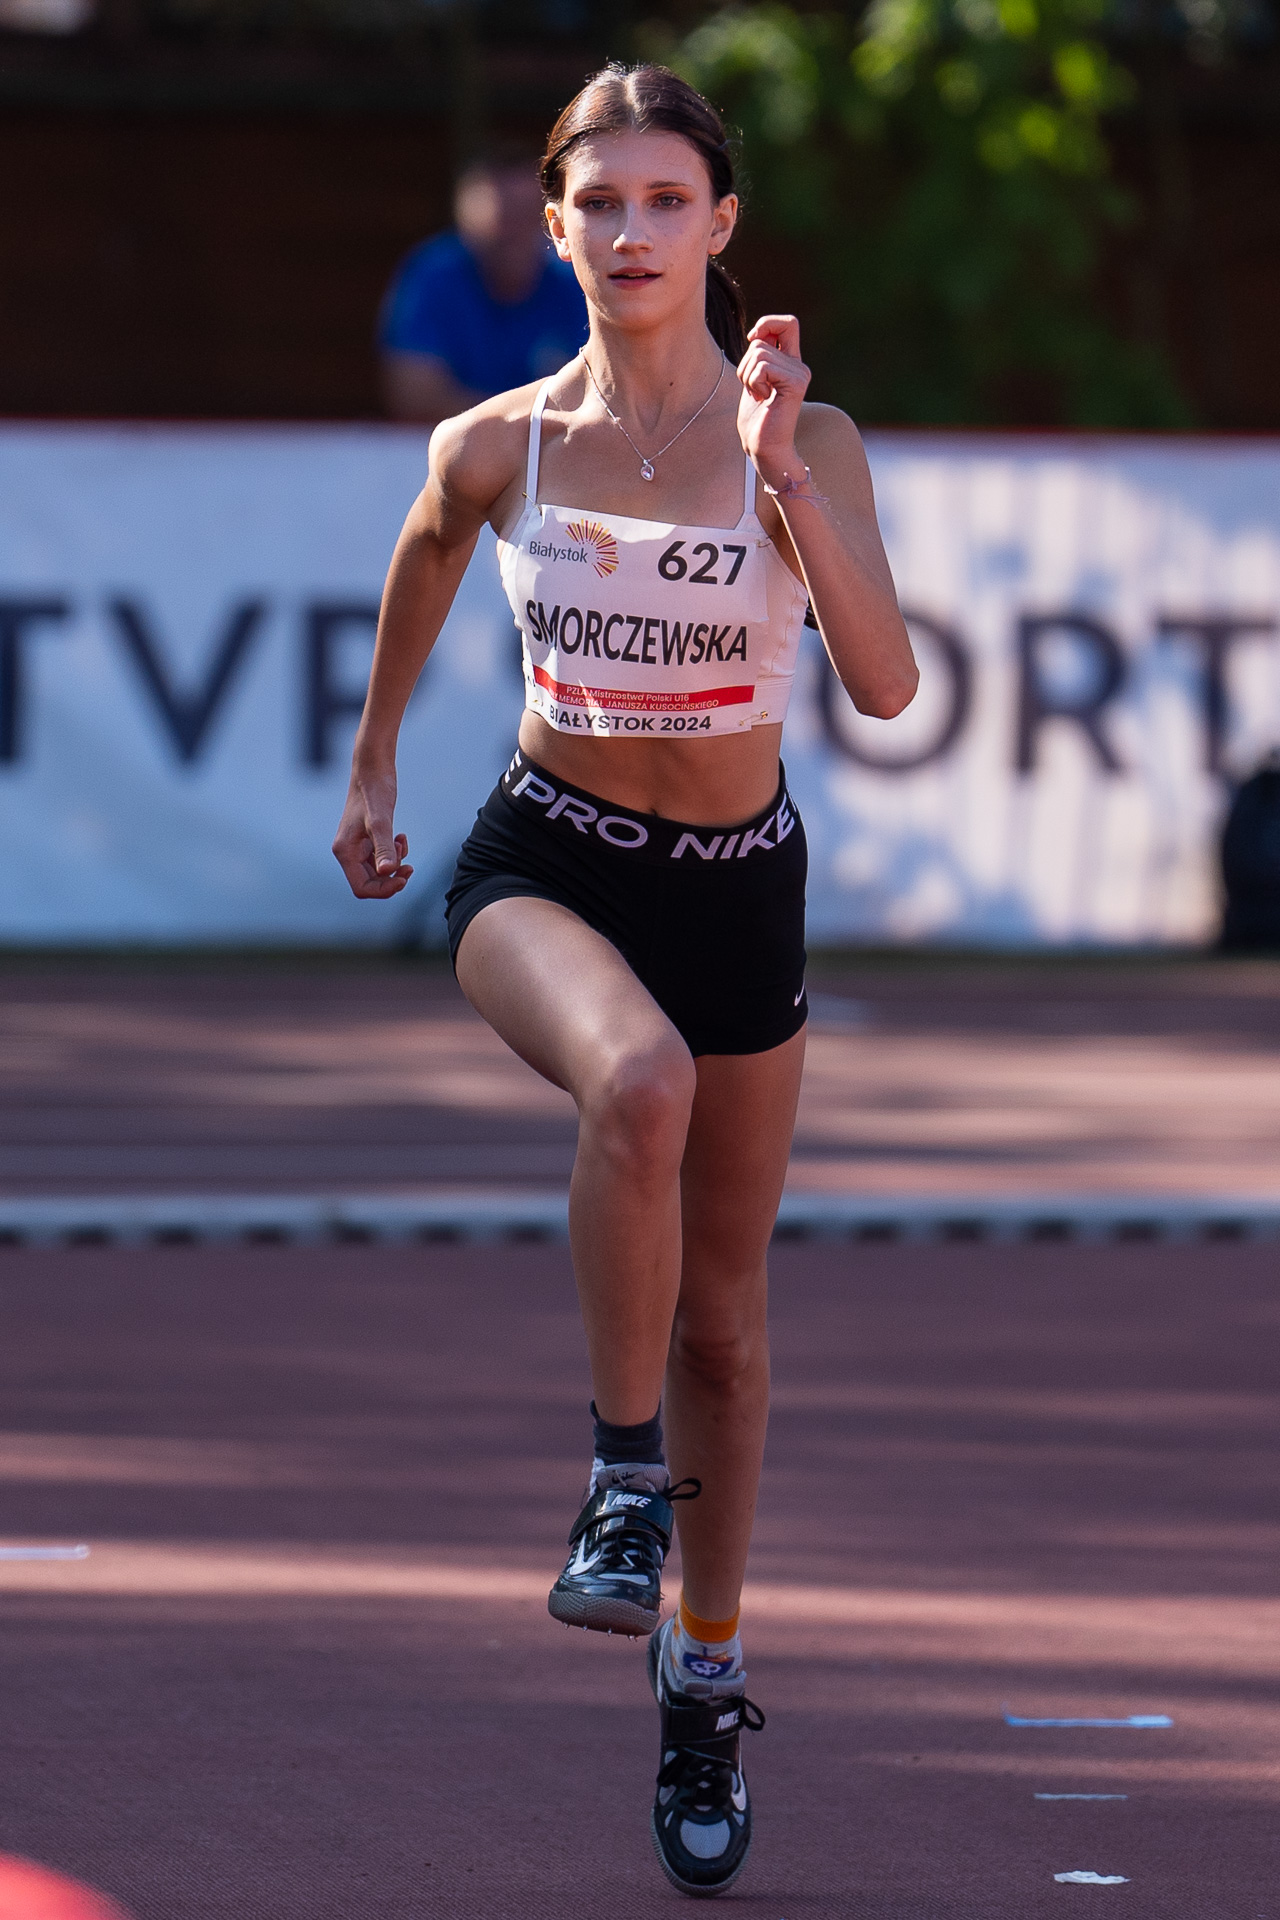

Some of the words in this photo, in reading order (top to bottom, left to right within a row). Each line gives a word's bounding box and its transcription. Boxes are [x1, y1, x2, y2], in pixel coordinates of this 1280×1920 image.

[529, 541, 588, 563] Białystok
[657, 540, 748, 586] 627
[526, 599, 748, 667] SMORCZEWSKA
[0, 598, 382, 768] TVP
[814, 610, 1278, 774] ORT
[566, 686, 588, 697] PZLA
[589, 689, 644, 701] Mistrzostwa
[646, 693, 673, 702] Polski
[674, 693, 690, 702] U16
[558, 694, 604, 708] MEMORIAŁ
[605, 701, 648, 711] JANUSZA
[649, 699, 719, 711] KUSOCIŃSKIEGO
[549, 704, 656, 731] BIAŁYSTOK
[660, 715, 712, 731] 2024
[511, 771, 649, 849] PRO
[670, 792, 796, 860] NIKE
[611, 1493, 652, 1508] NIKE
